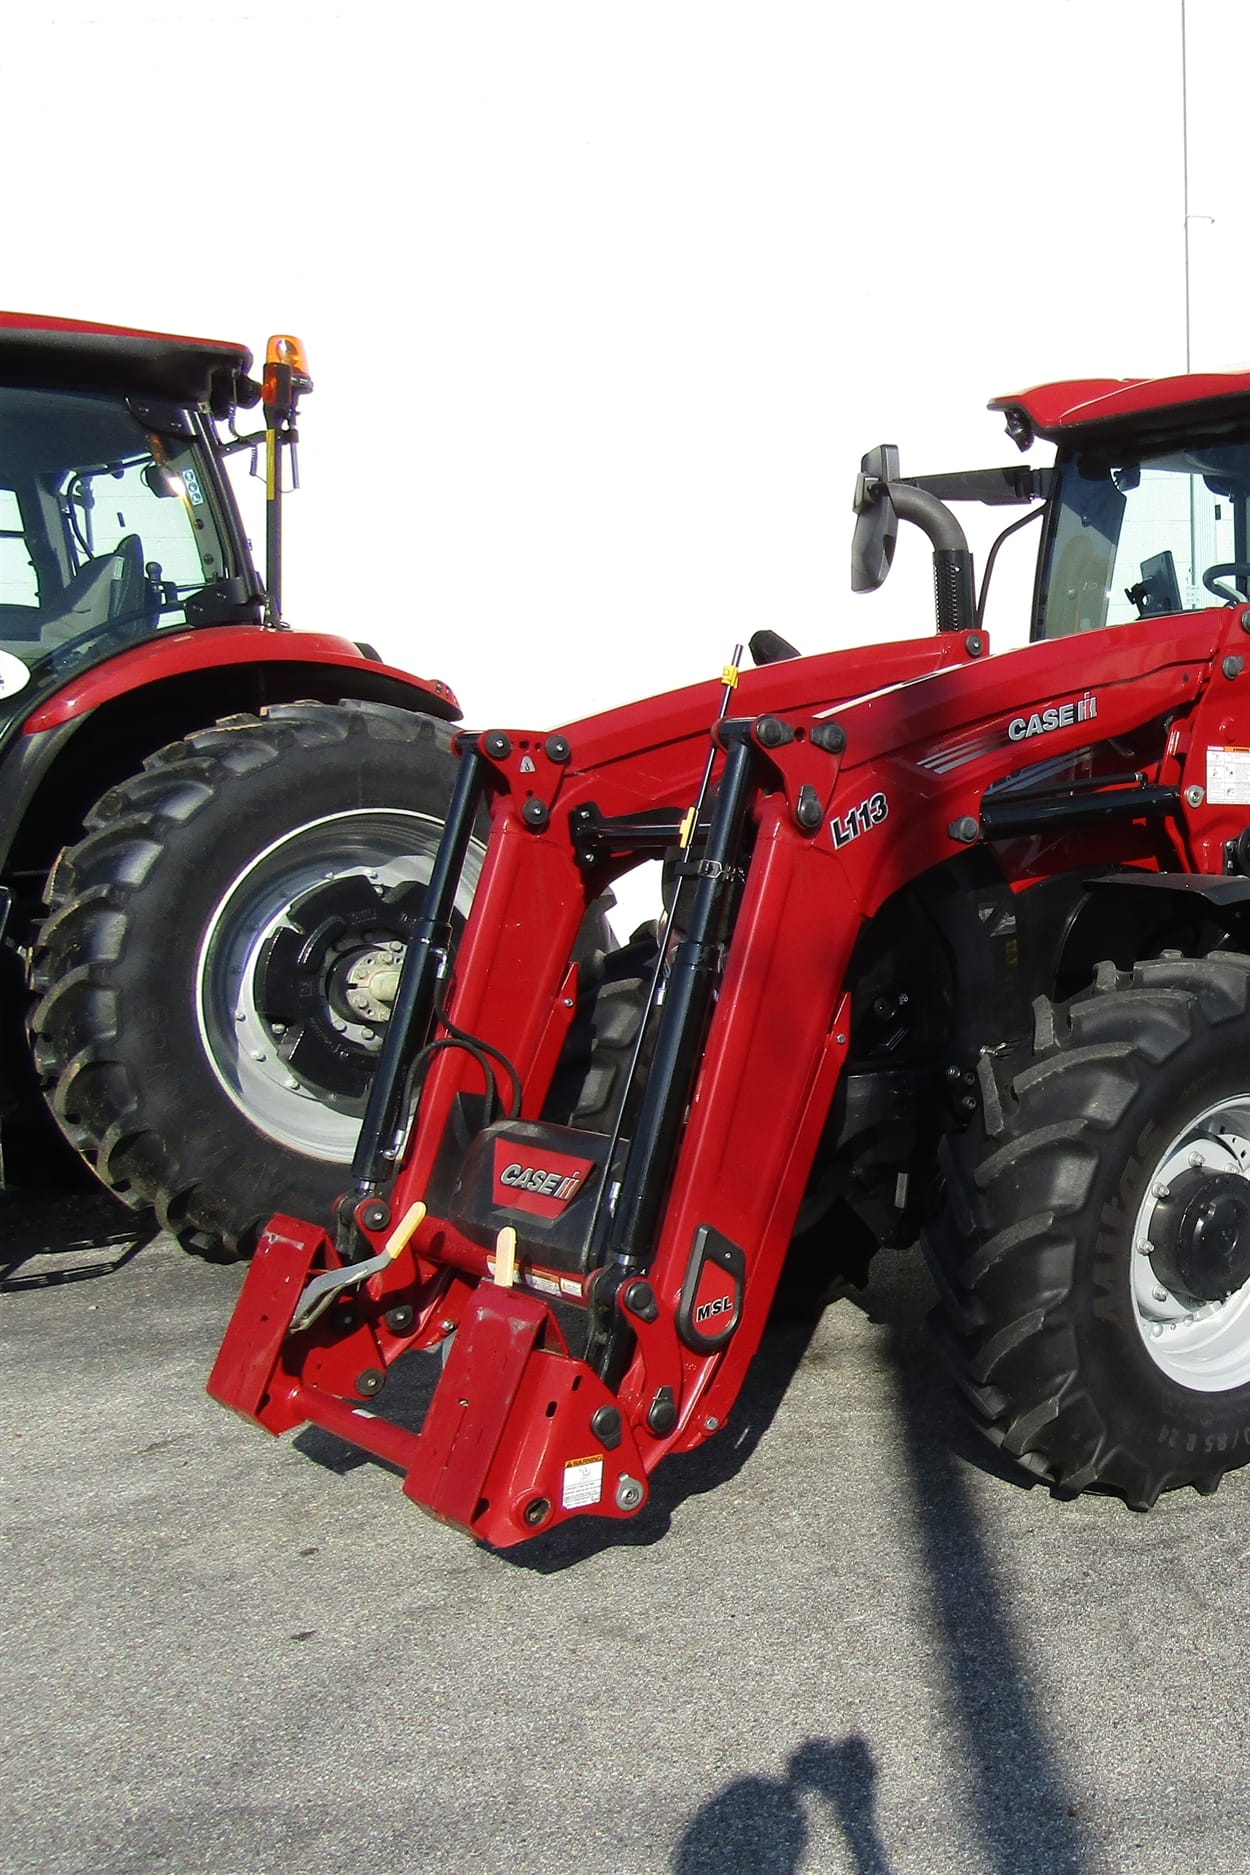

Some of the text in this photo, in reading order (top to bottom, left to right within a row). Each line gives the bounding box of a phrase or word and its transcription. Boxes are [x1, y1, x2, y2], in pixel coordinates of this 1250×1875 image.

[1008, 703, 1074, 741] CASE
[830, 792, 889, 850] L113
[501, 1163, 562, 1195] CASE
[696, 1295, 733, 1323] MSL
